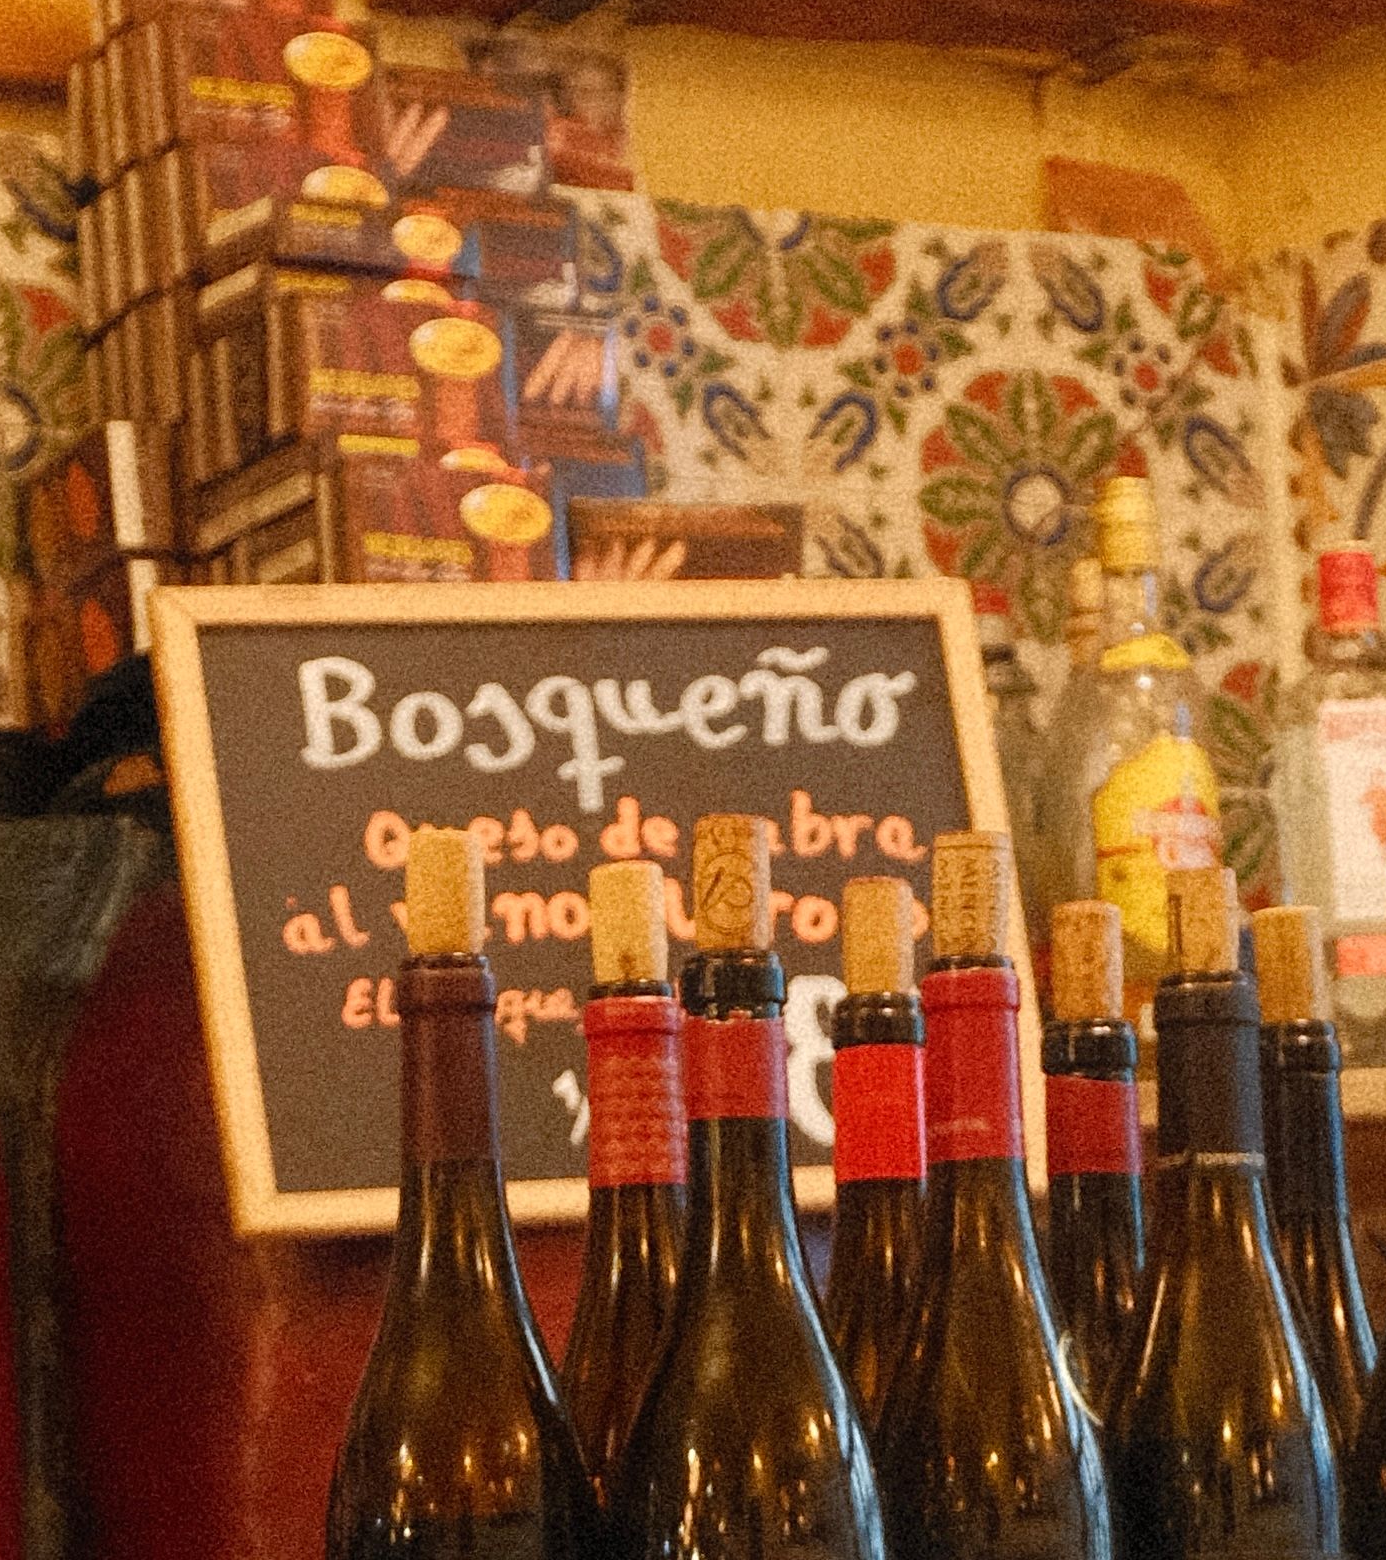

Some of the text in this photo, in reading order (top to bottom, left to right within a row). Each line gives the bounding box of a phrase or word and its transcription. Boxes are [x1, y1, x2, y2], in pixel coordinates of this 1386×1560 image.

[297, 646, 918, 812] Bosqueño
[365, 810, 580, 870] Qeso
[599, 796, 680, 860] de
